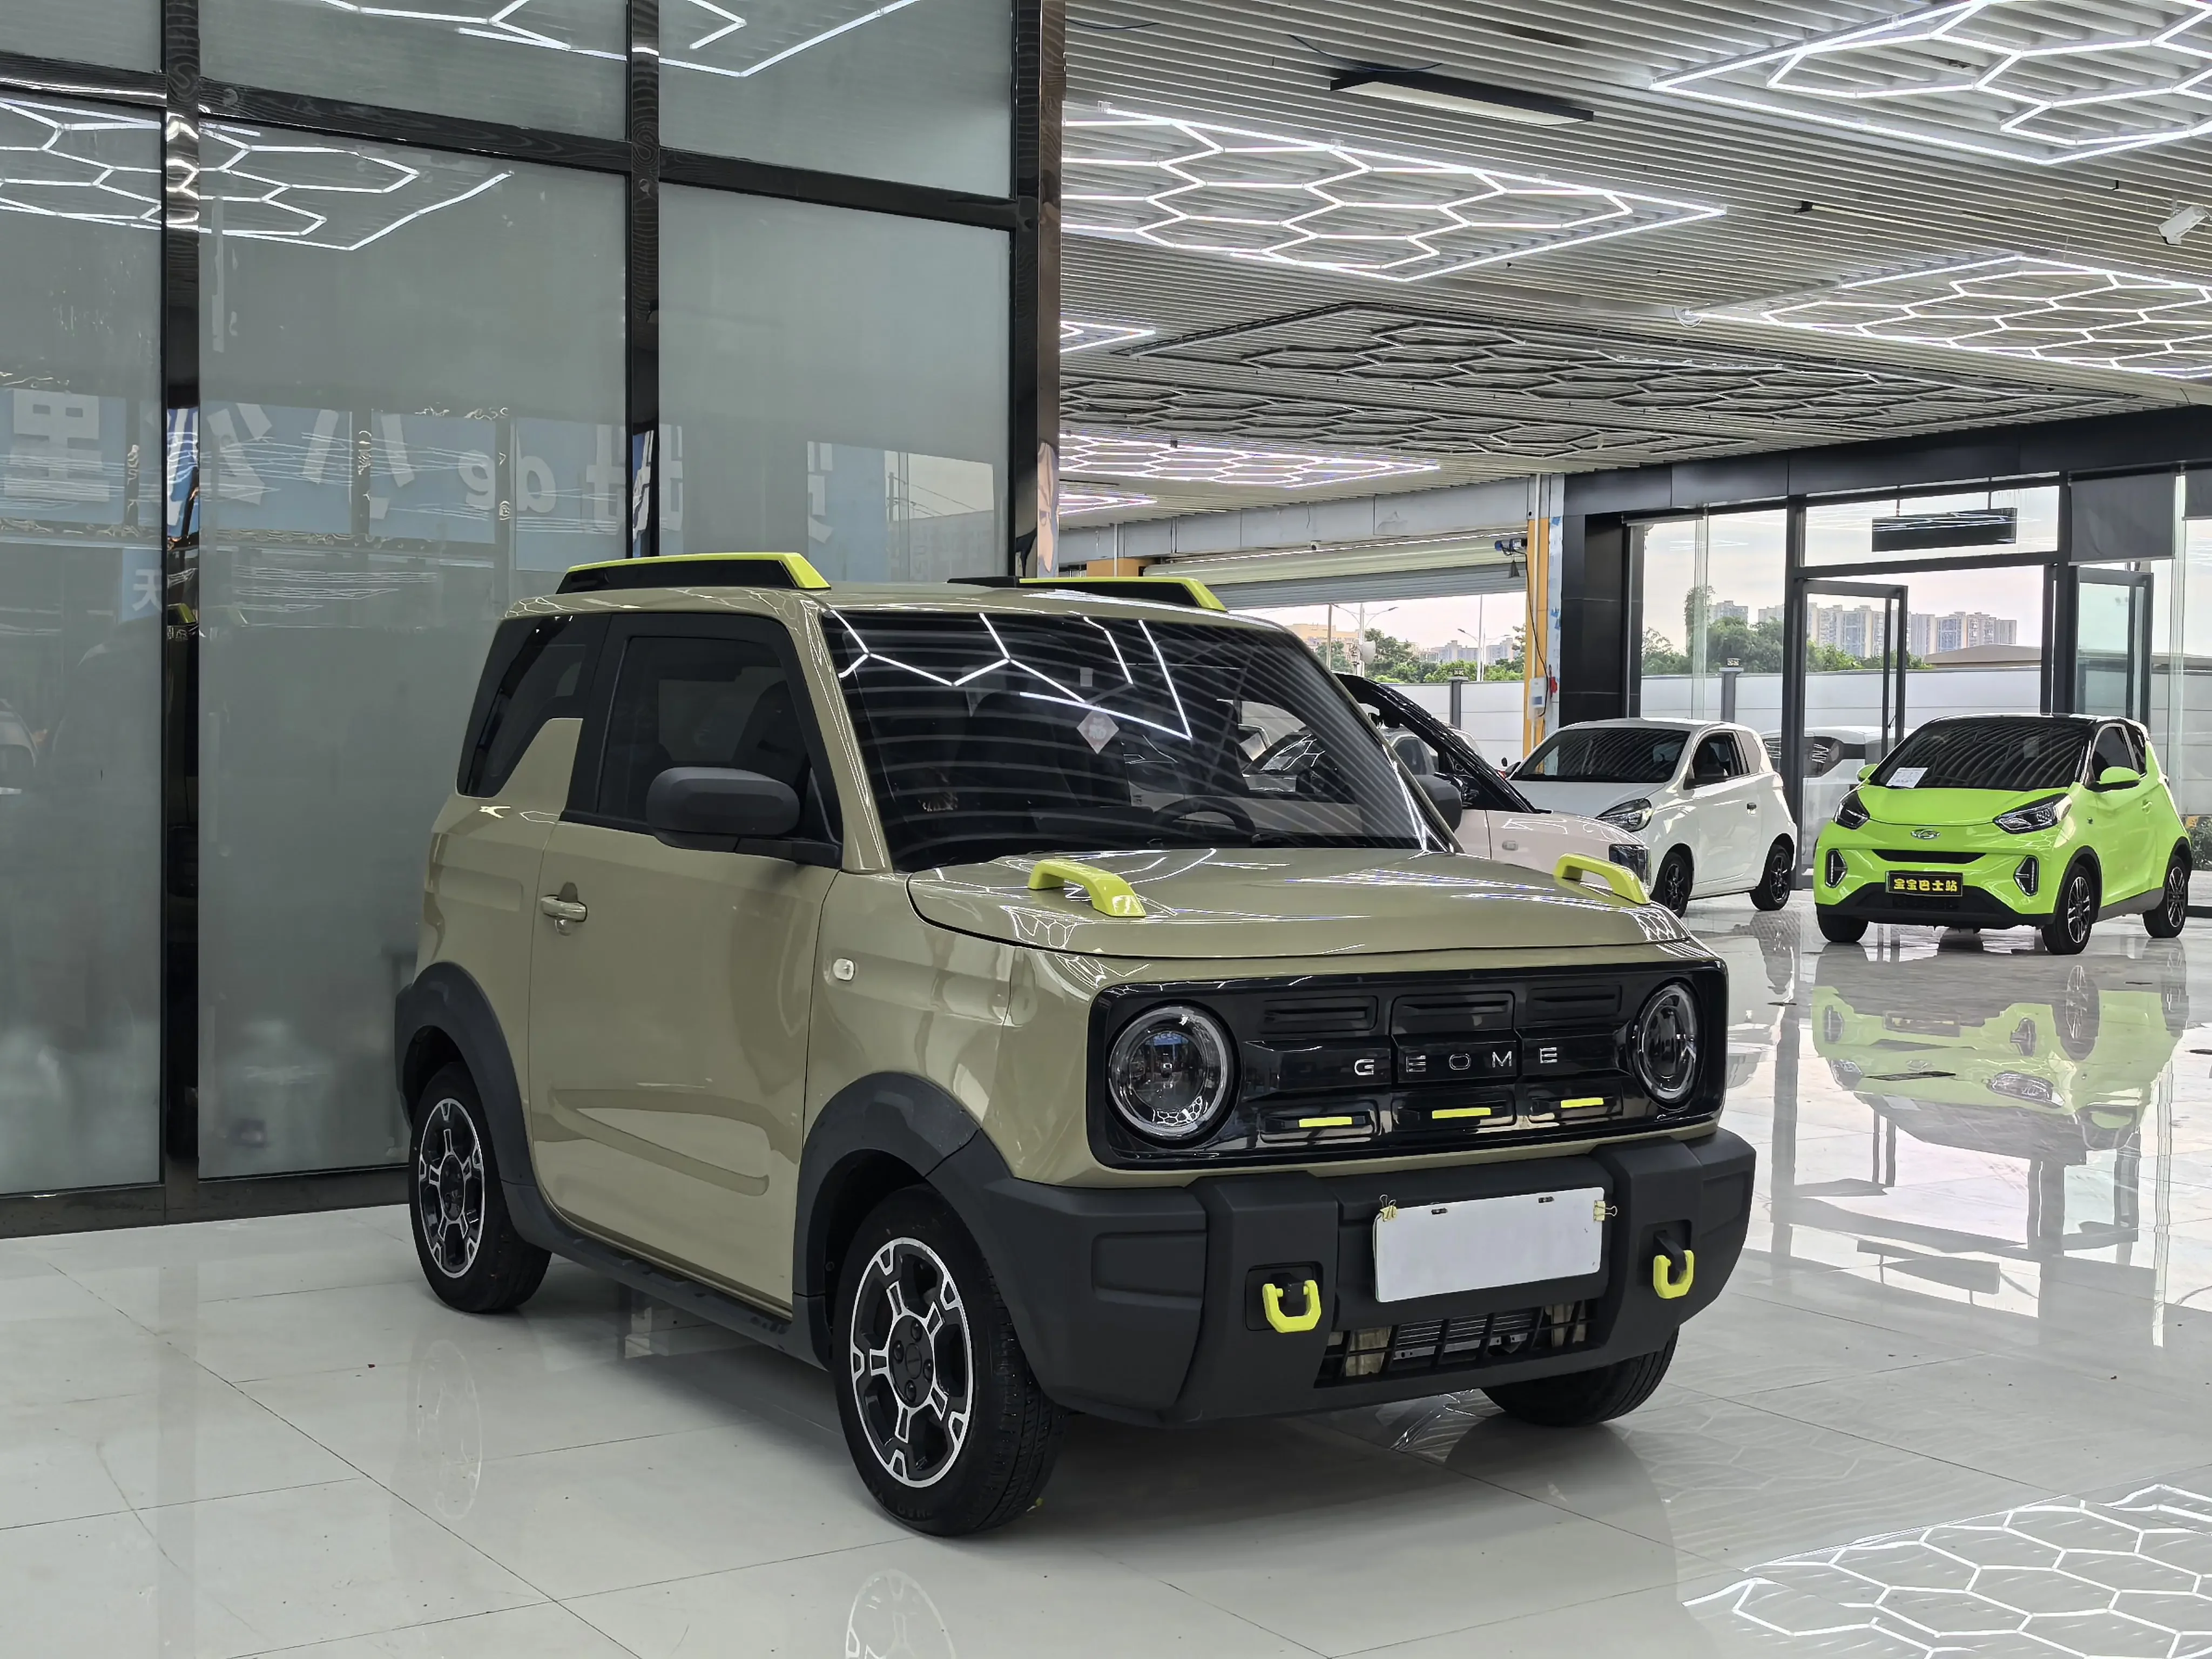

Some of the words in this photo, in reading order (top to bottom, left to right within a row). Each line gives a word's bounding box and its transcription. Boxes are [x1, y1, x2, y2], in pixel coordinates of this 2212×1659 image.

[1893, 878, 1958, 892] 宝宝巴士站
[1354, 1047, 1558, 1076] GEOME
